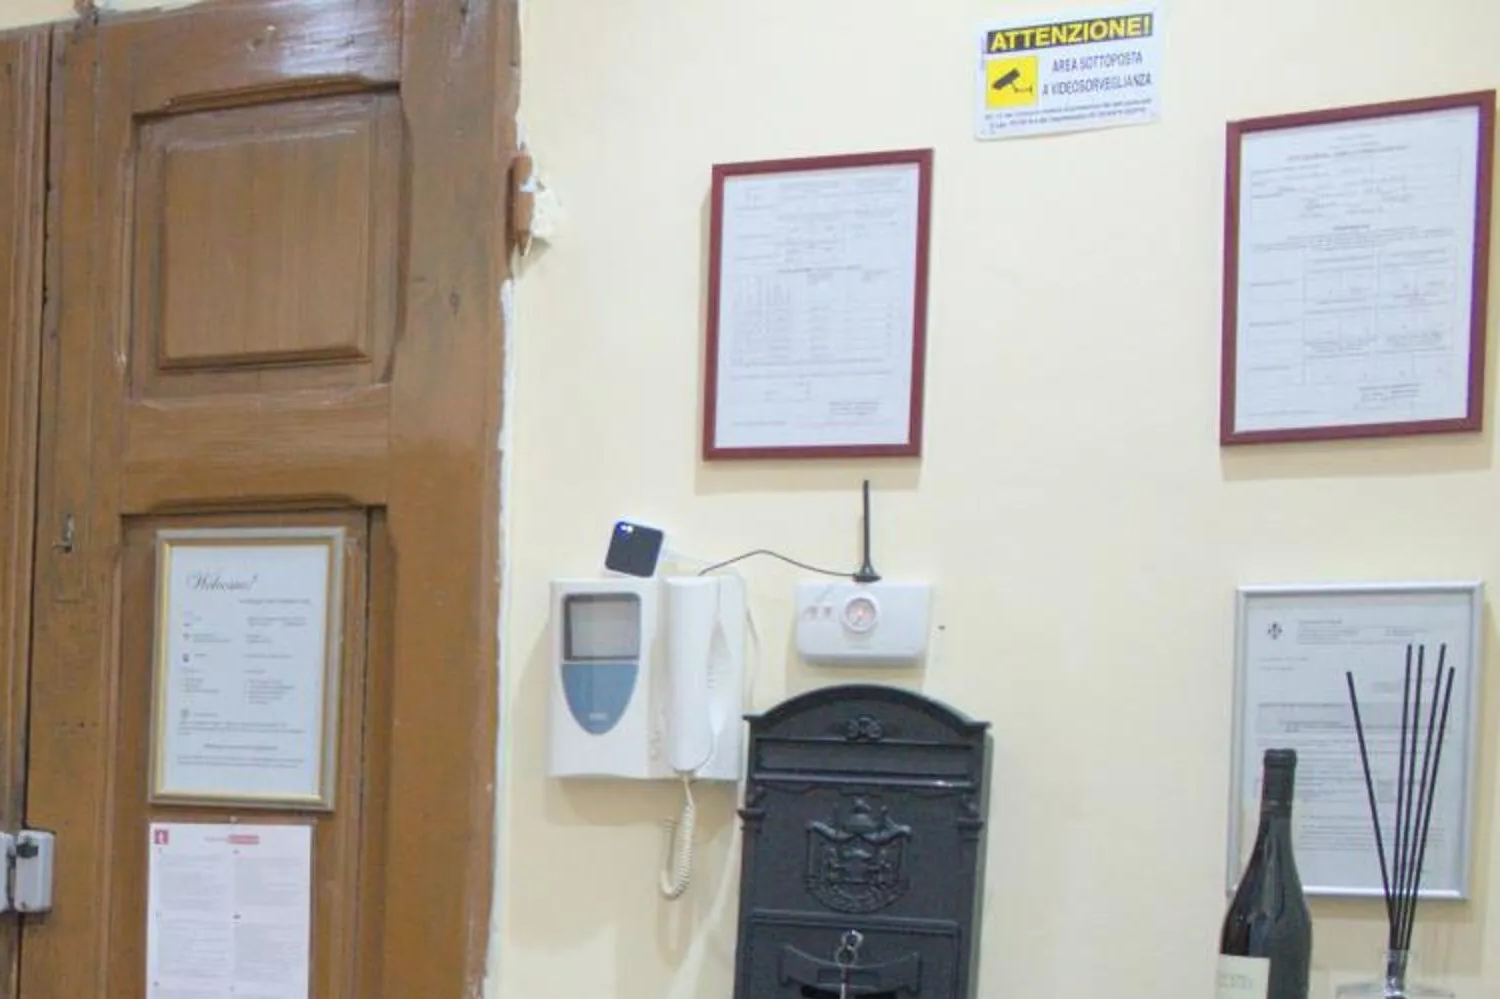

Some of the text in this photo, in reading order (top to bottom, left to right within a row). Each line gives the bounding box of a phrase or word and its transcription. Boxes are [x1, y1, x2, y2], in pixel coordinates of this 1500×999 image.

[990, 16, 1150, 52] ATTENZIONE!
[1051, 51, 1144, 73] AREA SOTTOPOSTA
